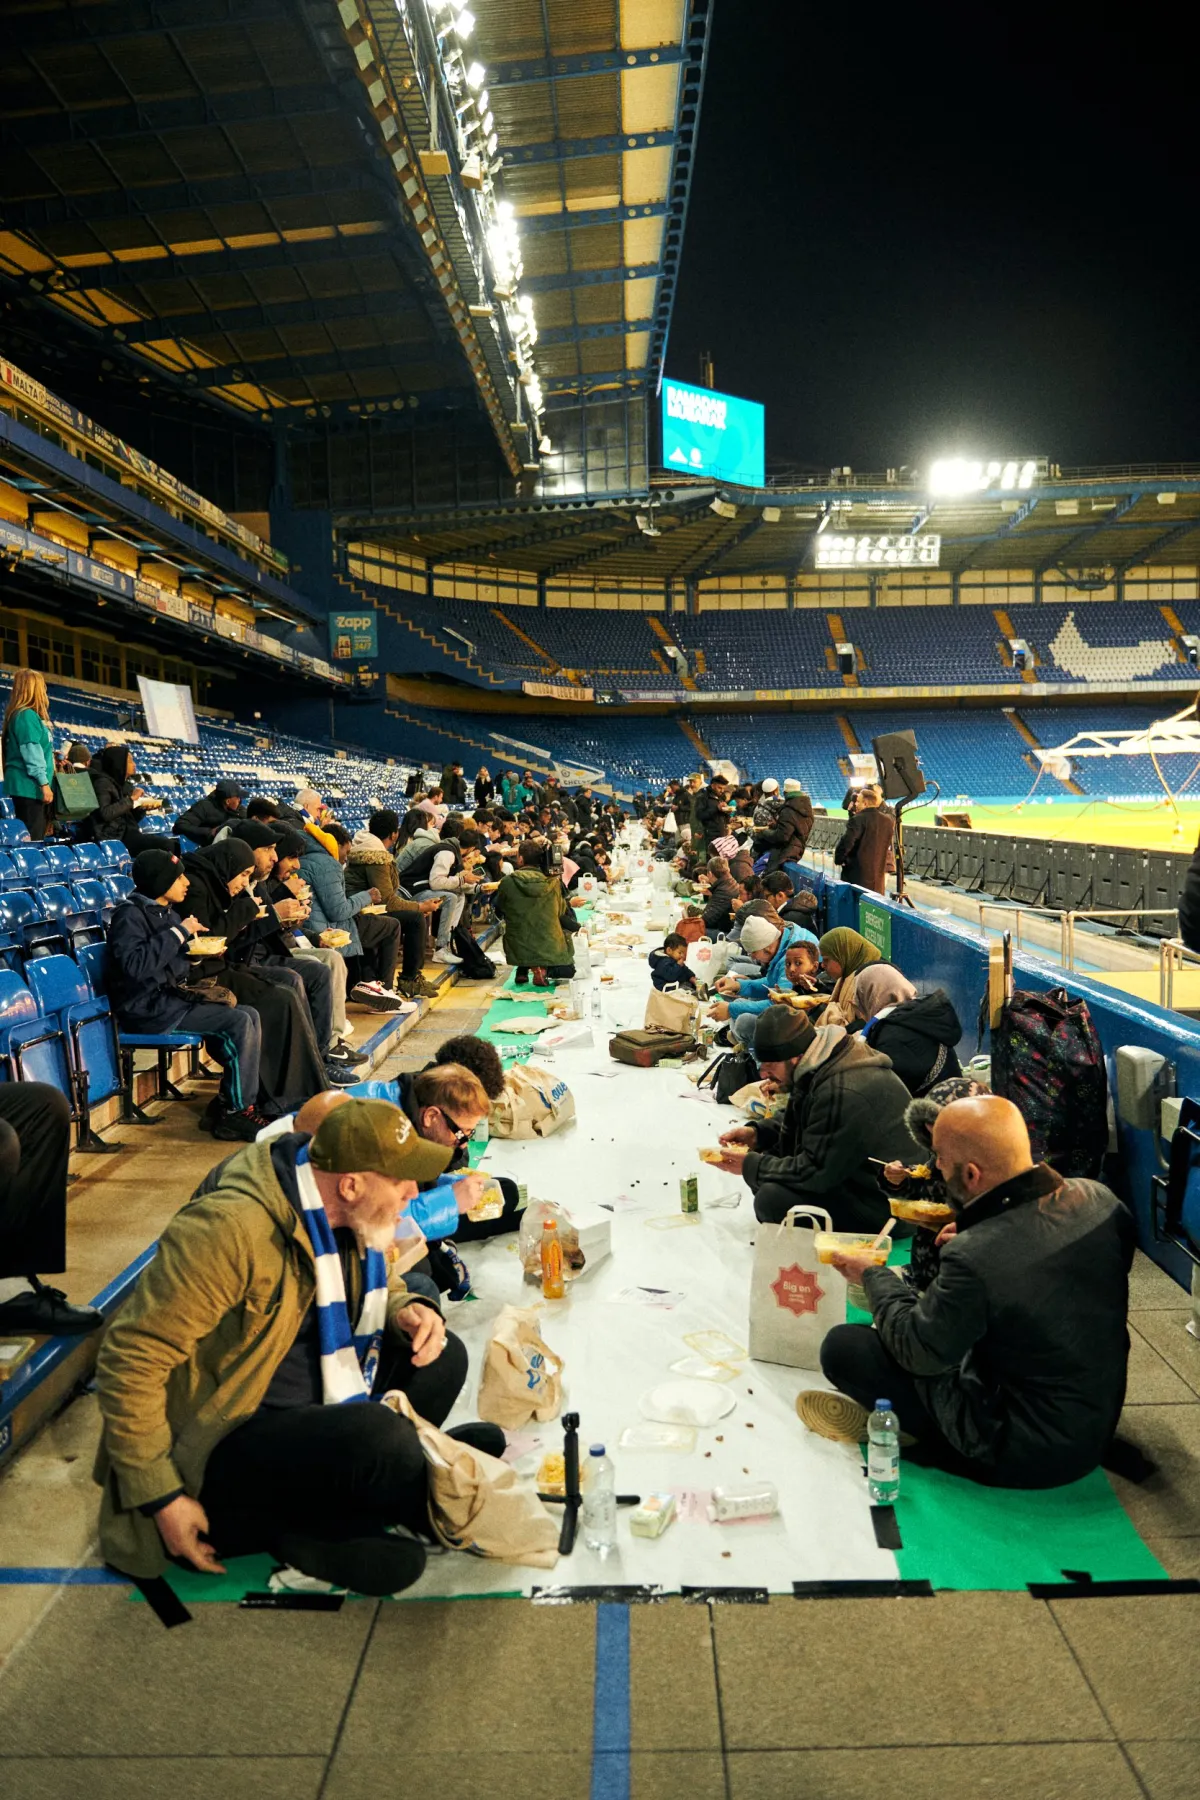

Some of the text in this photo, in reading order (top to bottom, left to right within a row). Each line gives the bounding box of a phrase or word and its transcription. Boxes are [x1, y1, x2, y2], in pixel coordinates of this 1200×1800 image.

[13, 373, 38, 400] MALTA
[336, 615, 372, 631] Zapp
[865, 911, 884, 931] EMERGENCY
[783, 1280, 797, 1293] Big
